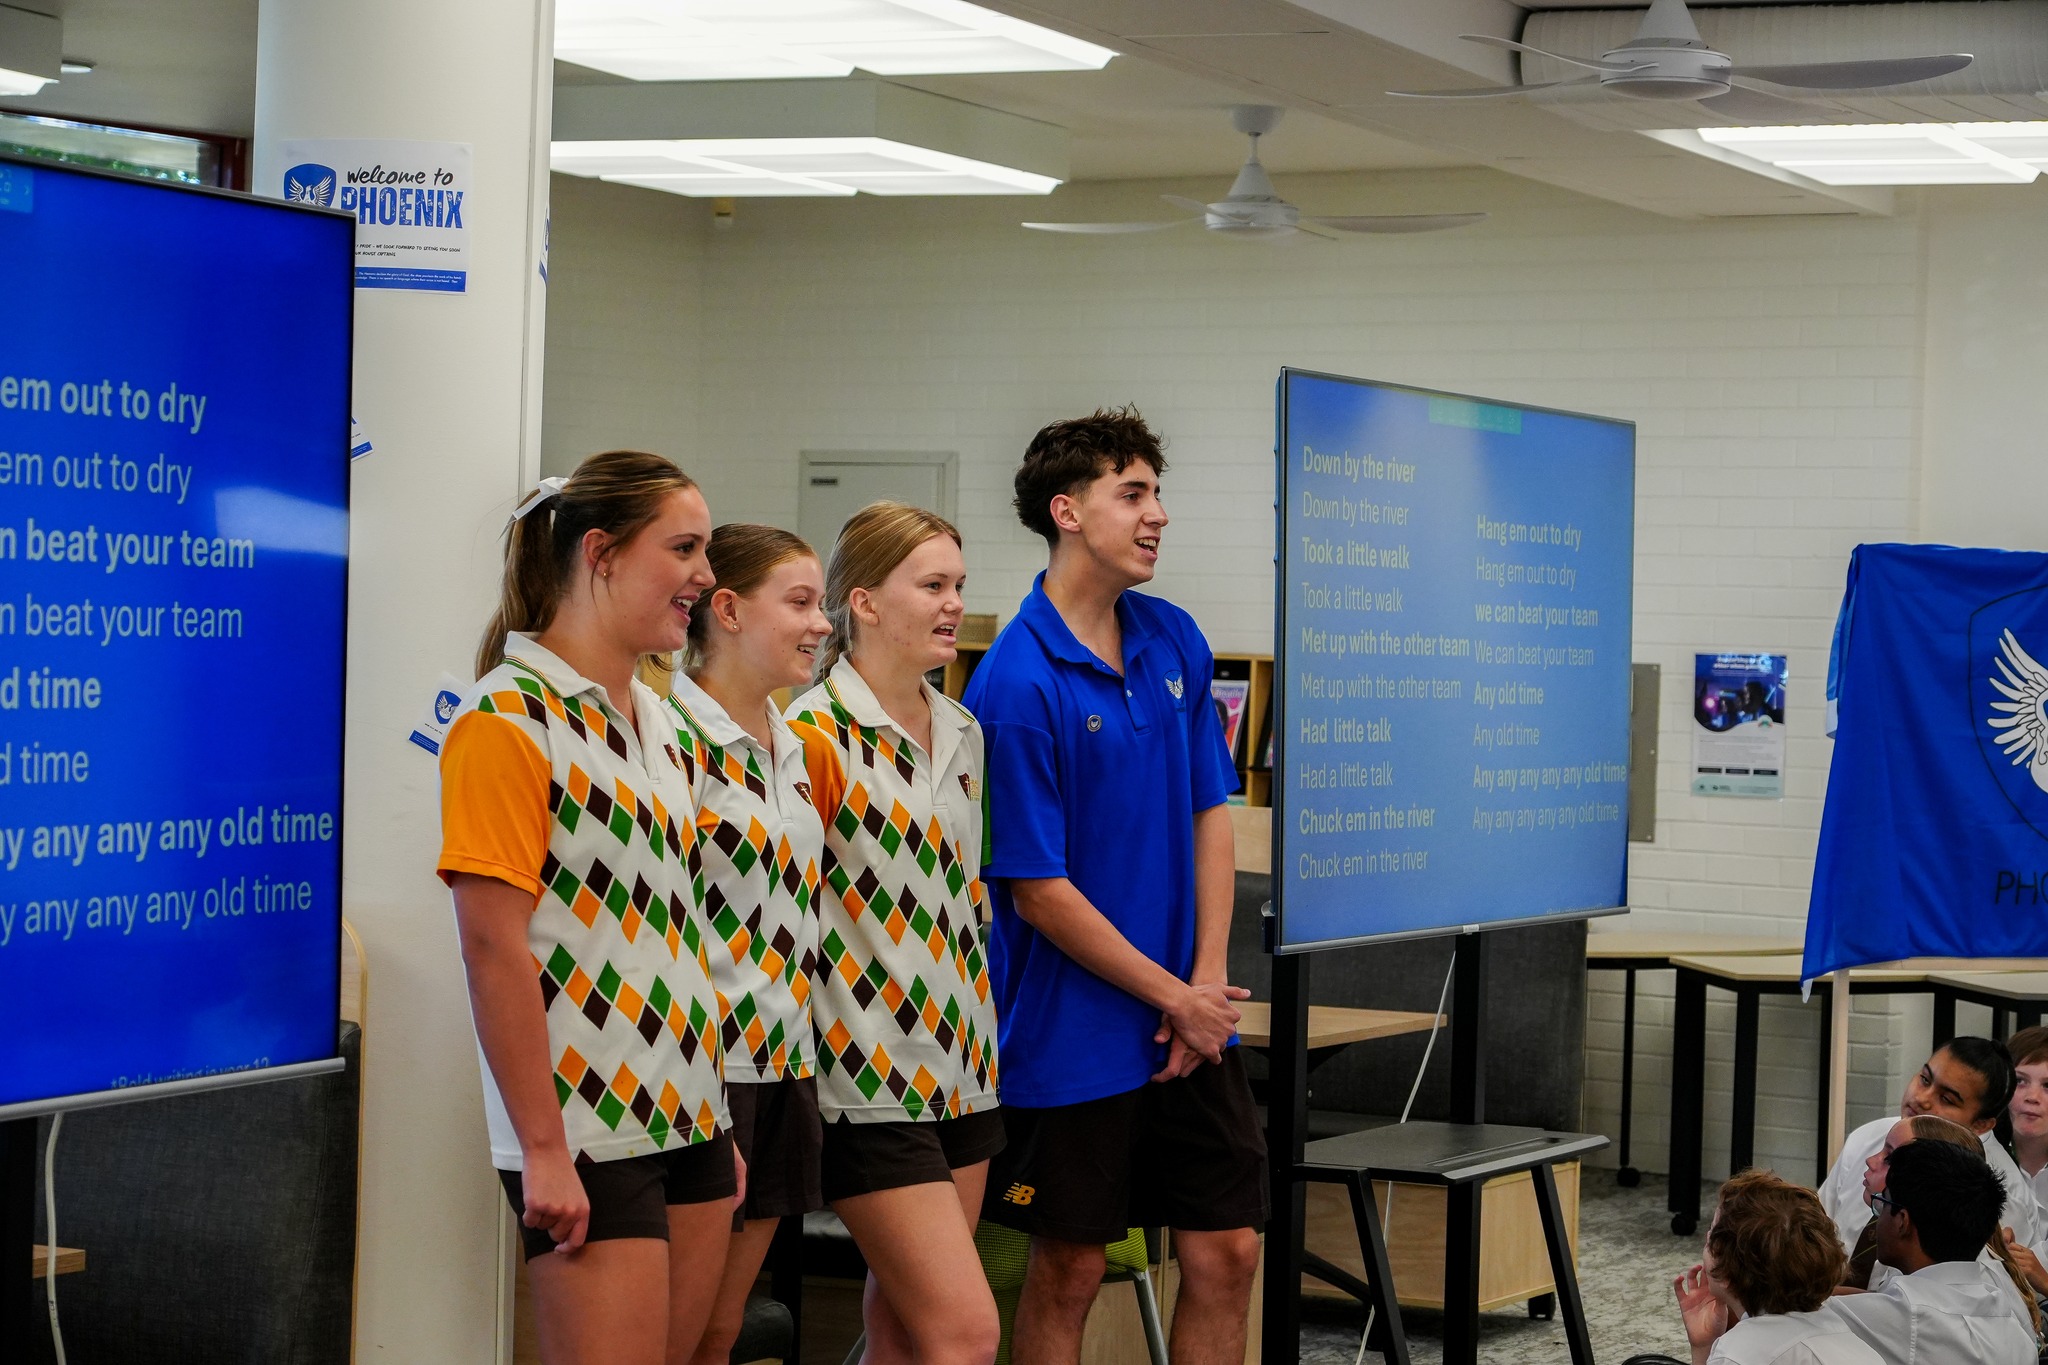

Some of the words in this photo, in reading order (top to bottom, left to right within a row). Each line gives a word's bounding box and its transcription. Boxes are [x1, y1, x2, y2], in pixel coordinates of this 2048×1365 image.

[347, 165, 427, 184] welcome
[433, 167, 454, 186] to
[340, 186, 464, 229] PHOENIX
[0, 376, 51, 412] em
[60, 380, 112, 417] out
[120, 382, 150, 420] to
[158, 382, 206, 434] dry
[0, 452, 42, 485] em
[52, 452, 102, 490] out
[110, 455, 138, 492] to
[147, 453, 192, 504] dry
[1302, 445, 1341, 474] Down
[1344, 450, 1360, 483] by
[1362, 454, 1384, 480] the
[1386, 457, 1416, 482] river
[1302, 490, 1340, 520] Down
[1342, 496, 1358, 528] by
[1360, 498, 1380, 523] the
[1382, 501, 1410, 526] river
[26, 518, 98, 562] beat
[106, 532, 173, 574] your
[180, 530, 254, 568] team
[1476, 514, 1509, 546] Hang
[1510, 524, 1528, 541] em
[1530, 524, 1550, 544] out
[1550, 527, 1563, 545] to
[1563, 527, 1582, 552] dry
[1302, 536, 1334, 564] Took
[1336, 546, 1344, 564] a
[1346, 540, 1377, 568] little
[1380, 544, 1410, 570] walk
[1476, 556, 1505, 588] Hang
[1507, 566, 1524, 582] em
[1527, 566, 1545, 584] out
[1546, 565, 1558, 585] to
[1560, 563, 1576, 592] dry
[1302, 582, 1332, 608] Took
[1334, 590, 1342, 610] a
[1344, 586, 1372, 612] little
[1375, 588, 1402, 612] walk
[26, 593, 93, 636] beat
[100, 605, 165, 646] your
[172, 602, 242, 638] team
[1474, 604, 1492, 622] we
[1495, 606, 1516, 623] can
[1518, 602, 1542, 624] beat
[1544, 607, 1570, 631] your
[1571, 607, 1598, 626] team
[1302, 626, 1327, 653] Met
[1329, 629, 1347, 660] up
[1348, 629, 1378, 654] with
[1380, 630, 1401, 656] the
[1404, 632, 1437, 656] other
[1439, 635, 1470, 656] team
[1474, 640, 1493, 664] We
[1494, 646, 1514, 664] can
[1518, 643, 1541, 664] beat
[1542, 647, 1566, 670] your
[1568, 646, 1594, 666] team
[28, 666, 102, 709] time
[1300, 672, 1326, 698] Met
[1328, 679, 1344, 704] up
[1347, 674, 1373, 698] with
[1376, 674, 1396, 698] the
[1398, 676, 1430, 698] other
[1432, 678, 1462, 699] team
[1474, 681, 1496, 710] Any
[1498, 682, 1516, 705] old
[1518, 684, 1544, 704] time
[1300, 718, 1328, 744] Had
[1334, 718, 1364, 742] little
[1366, 718, 1392, 742] talk
[1473, 723, 1494, 752] Any
[1496, 723, 1514, 746] old
[1516, 725, 1540, 746] time
[20, 742, 90, 784] time
[1300, 763, 1326, 789] Had
[1330, 768, 1337, 788] a
[1340, 762, 1368, 788] little
[1370, 762, 1393, 786] talk
[1473, 764, 1496, 793] Any
[1496, 767, 1518, 792] any
[1520, 768, 1540, 790] any
[1541, 765, 1561, 790] any
[1562, 766, 1582, 788] any
[1584, 762, 1602, 783] old
[1602, 760, 1627, 782] time
[1299, 805, 1344, 835] Chuck
[1346, 812, 1366, 832] em
[1369, 809, 1382, 831] in
[1384, 805, 1404, 830] the
[1408, 802, 1436, 828] river
[1472, 806, 1494, 835] Any
[1495, 808, 1516, 833] any
[1517, 808, 1538, 832] any
[1538, 807, 1557, 830] any
[1558, 806, 1577, 829] any
[1578, 802, 1595, 824] old
[1596, 800, 1619, 822] time
[32, 824, 90, 866] any
[97, 822, 152, 862] any
[160, 818, 212, 858] any
[219, 806, 264, 847] old
[270, 804, 335, 844] time
[1299, 851, 1340, 880] Chuck
[1344, 856, 1364, 876] em
[1366, 850, 1378, 874] in
[1380, 849, 1400, 872] the
[1402, 847, 1429, 871] river
[24, 898, 79, 940] any
[86, 894, 138, 936] any
[146, 890, 196, 930] any
[204, 876, 245, 918] old
[253, 874, 312, 914] time
